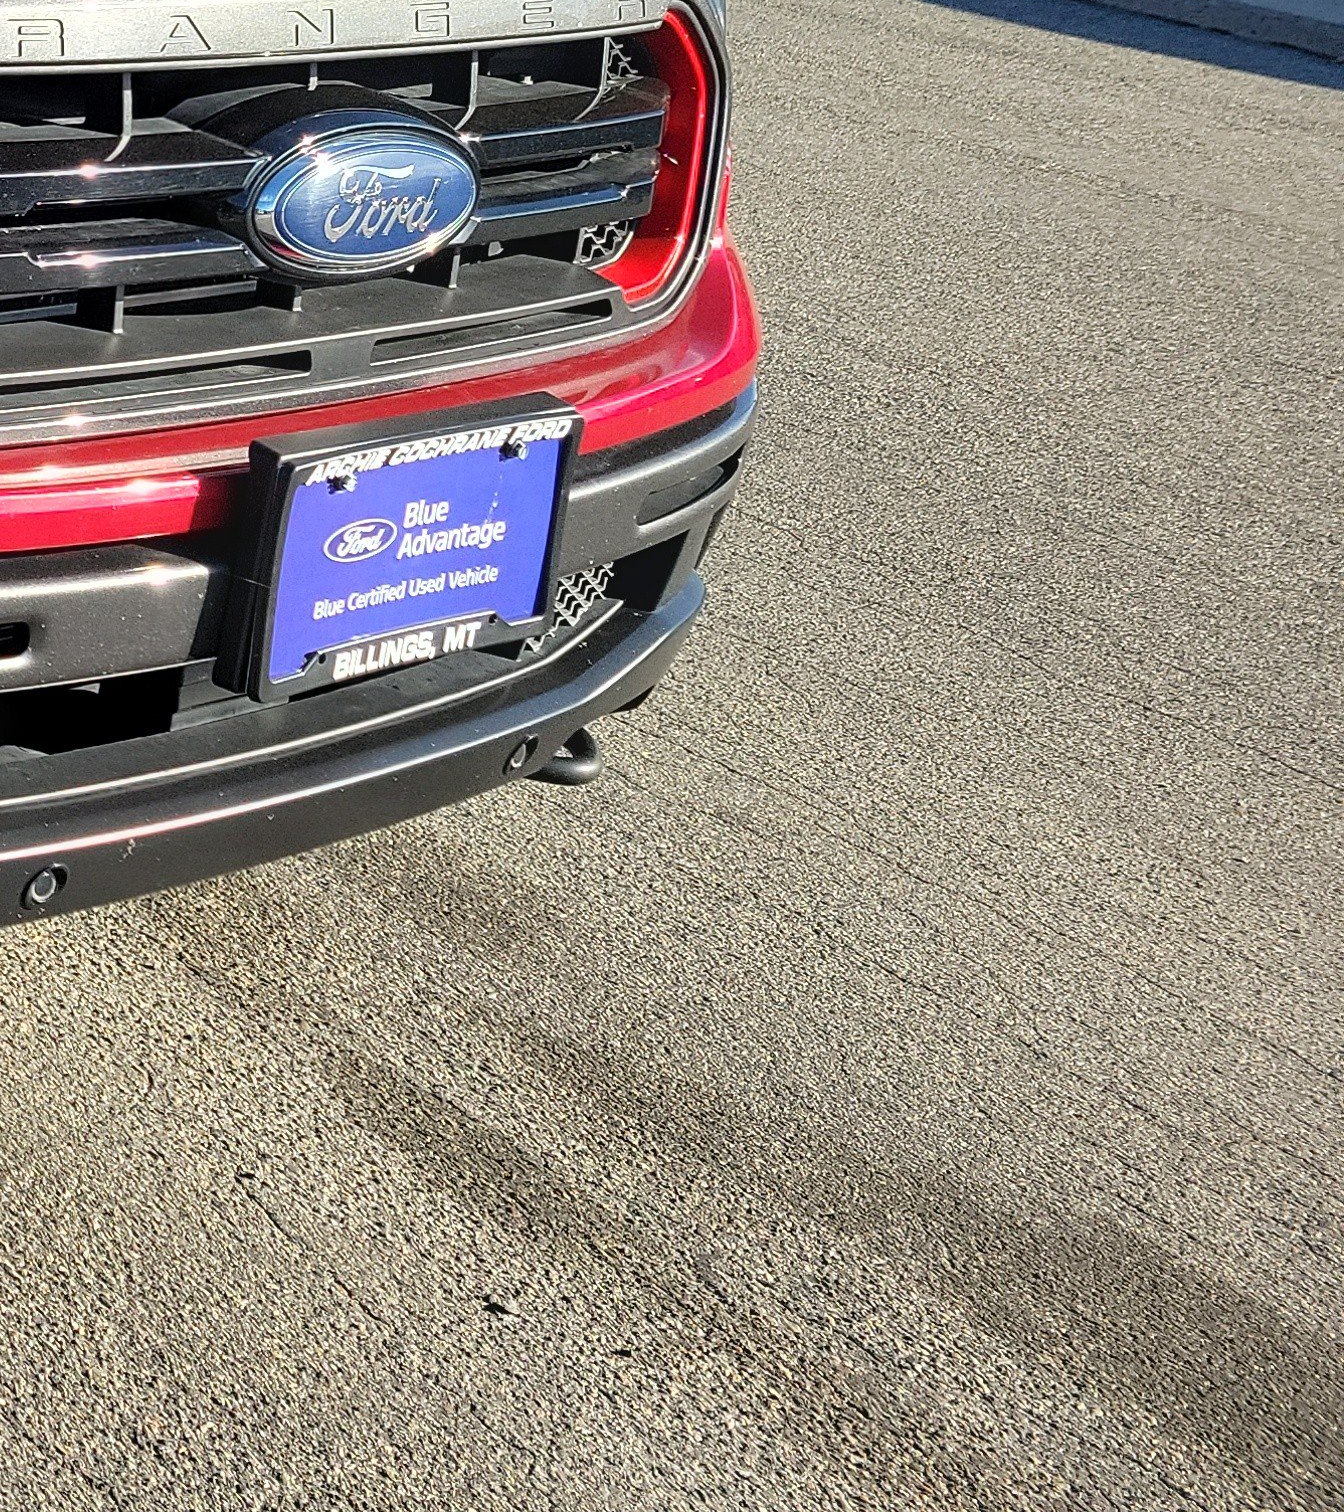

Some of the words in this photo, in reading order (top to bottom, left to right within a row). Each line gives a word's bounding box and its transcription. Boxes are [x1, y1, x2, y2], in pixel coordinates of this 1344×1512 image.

[323, 164, 441, 243] Ford
[305, 447, 392, 486] ARCHIE
[389, 427, 512, 467] COCHRANE
[508, 419, 573, 445] FORD
[337, 524, 385, 558] Ford
[396, 520, 507, 560] Advantage
[402, 499, 450, 529] Blue
[312, 598, 345, 621] Blue
[347, 580, 407, 611] Certified
[408, 571, 446, 597] Used
[448, 563, 499, 590] Vehicle
[333, 631, 436, 681] BILLINGS,
[442, 621, 482, 654] MT
